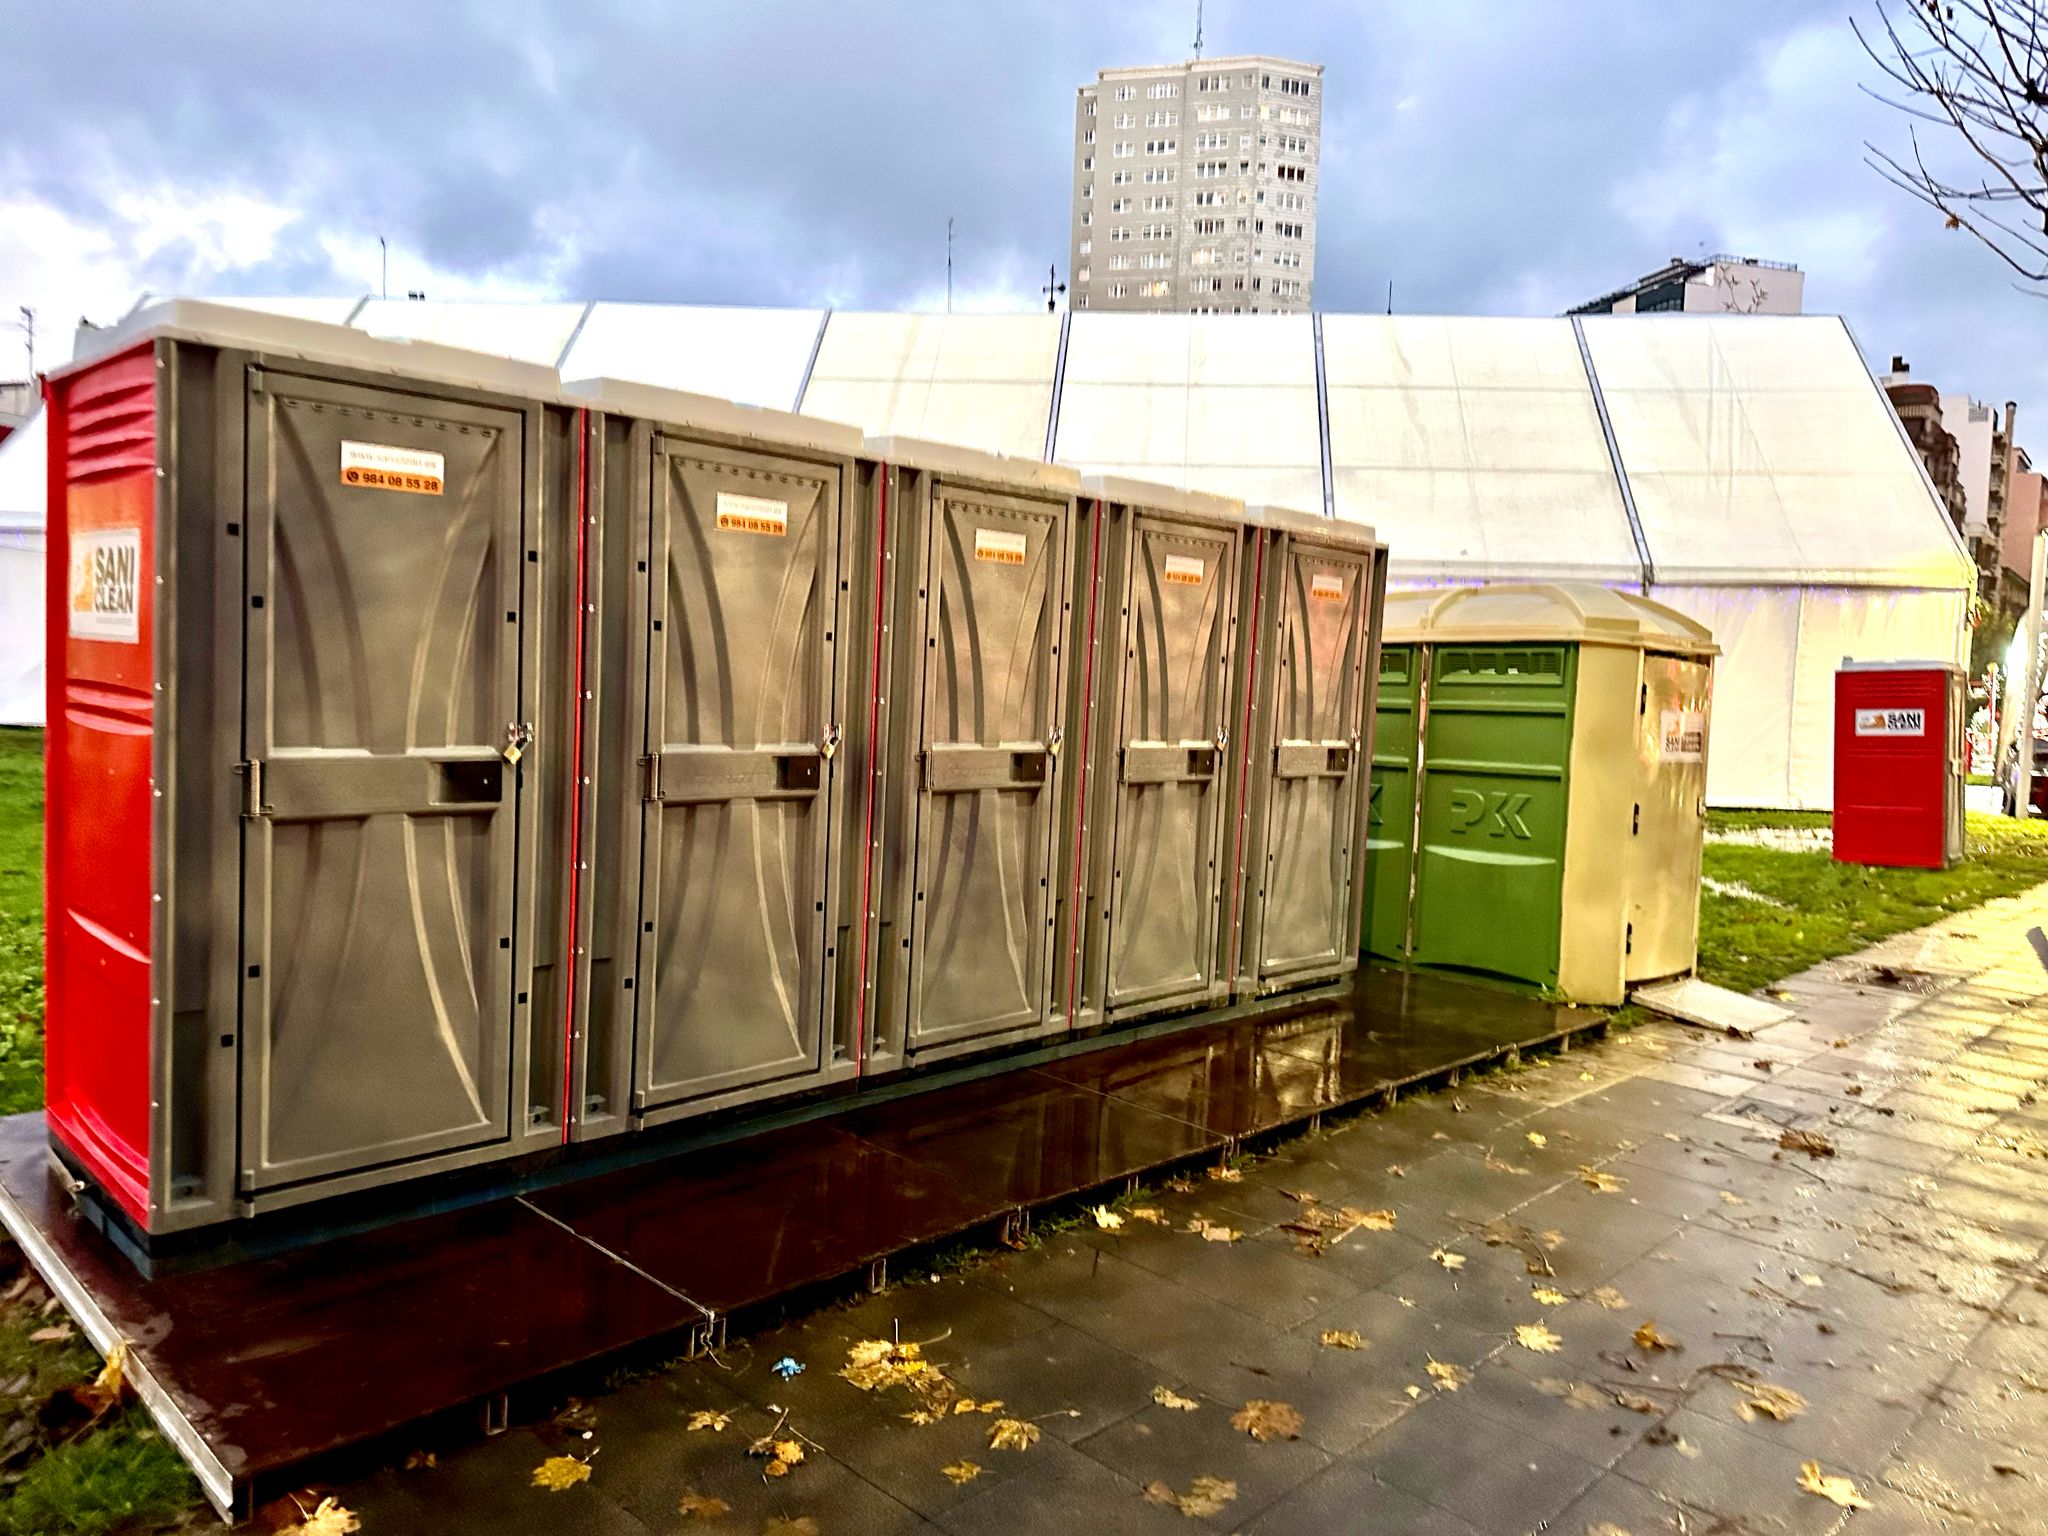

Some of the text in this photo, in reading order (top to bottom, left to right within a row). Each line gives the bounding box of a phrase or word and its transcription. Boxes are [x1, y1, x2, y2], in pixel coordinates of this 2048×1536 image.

[362, 473, 385, 485] 984
[388, 476, 403, 486] 08
[95, 545, 135, 585] SANI
[95, 584, 134, 614] CLEAN
